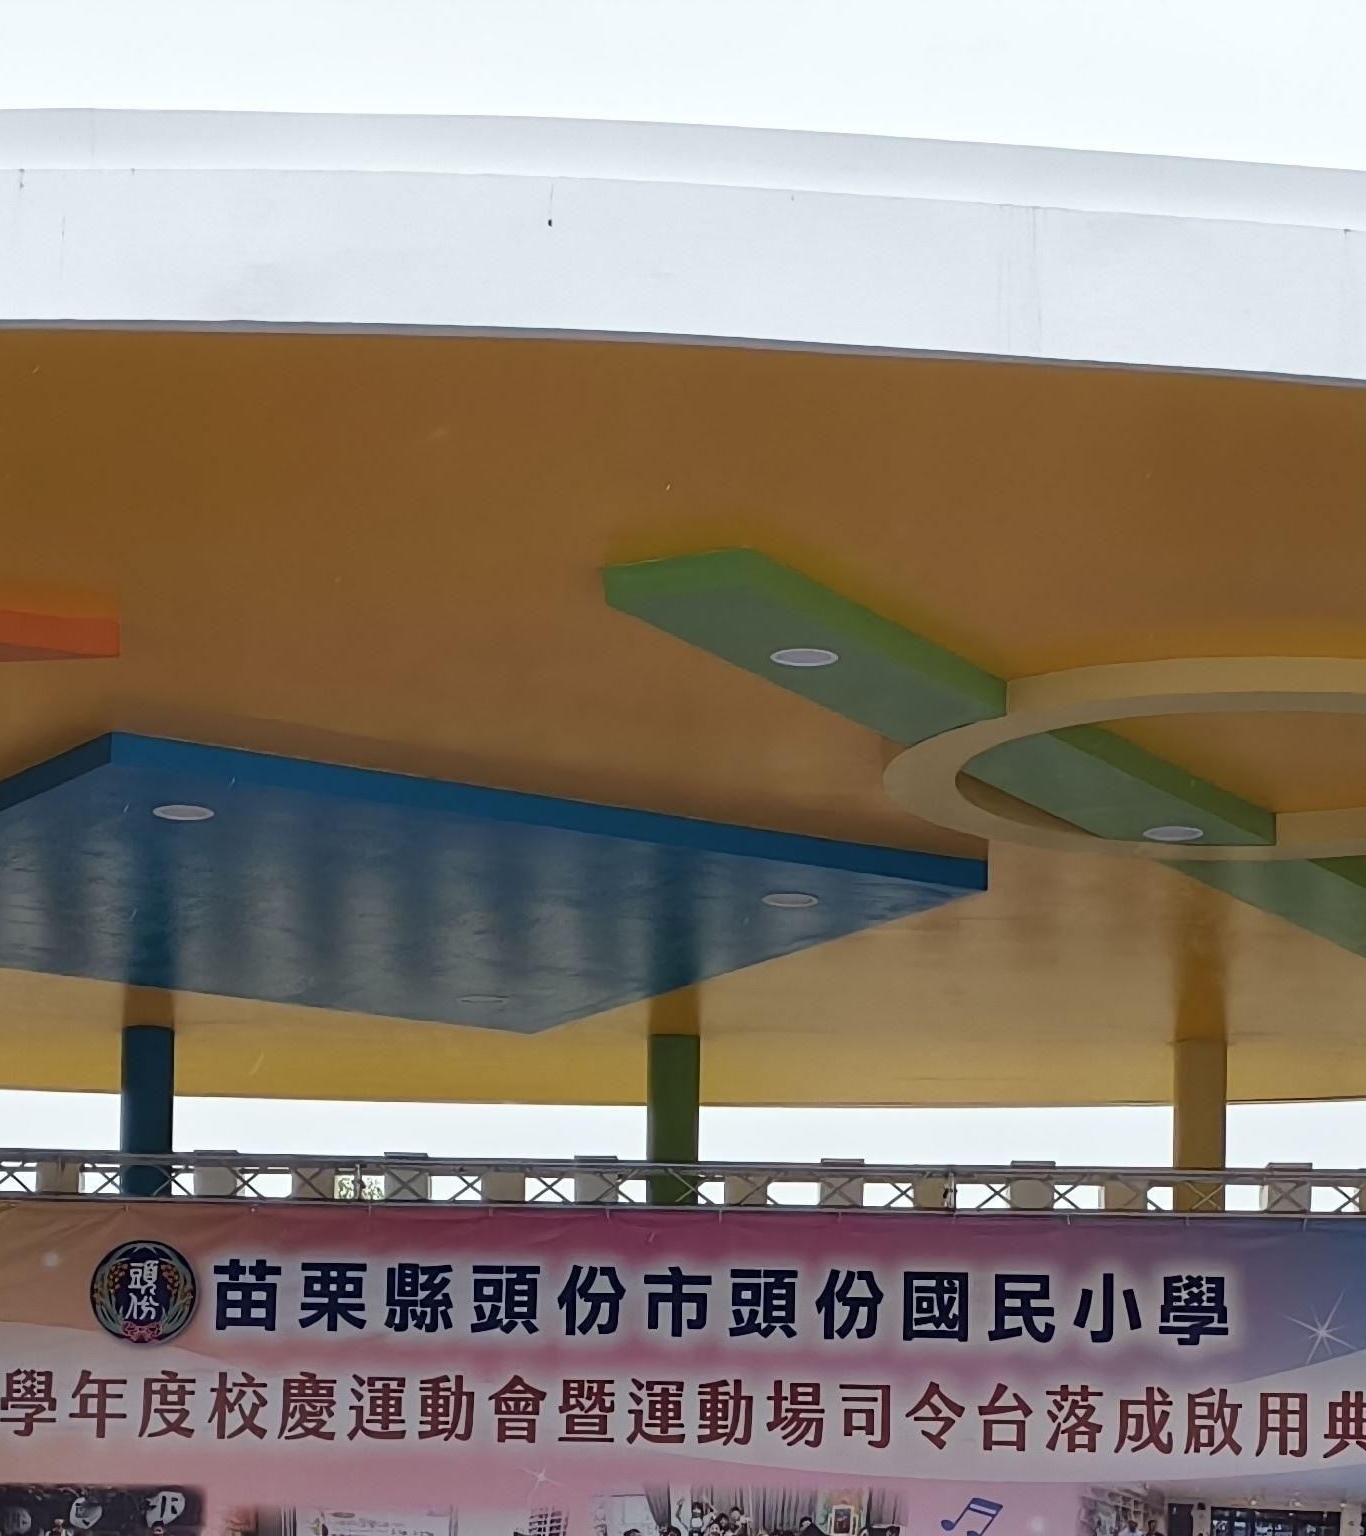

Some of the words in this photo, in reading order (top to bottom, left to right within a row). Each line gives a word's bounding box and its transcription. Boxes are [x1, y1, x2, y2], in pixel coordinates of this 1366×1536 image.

[124, 1259, 160, 1320] 頭份
[213, 1258, 1231, 1346] 苗栗縣頭份市頭份國民小學
